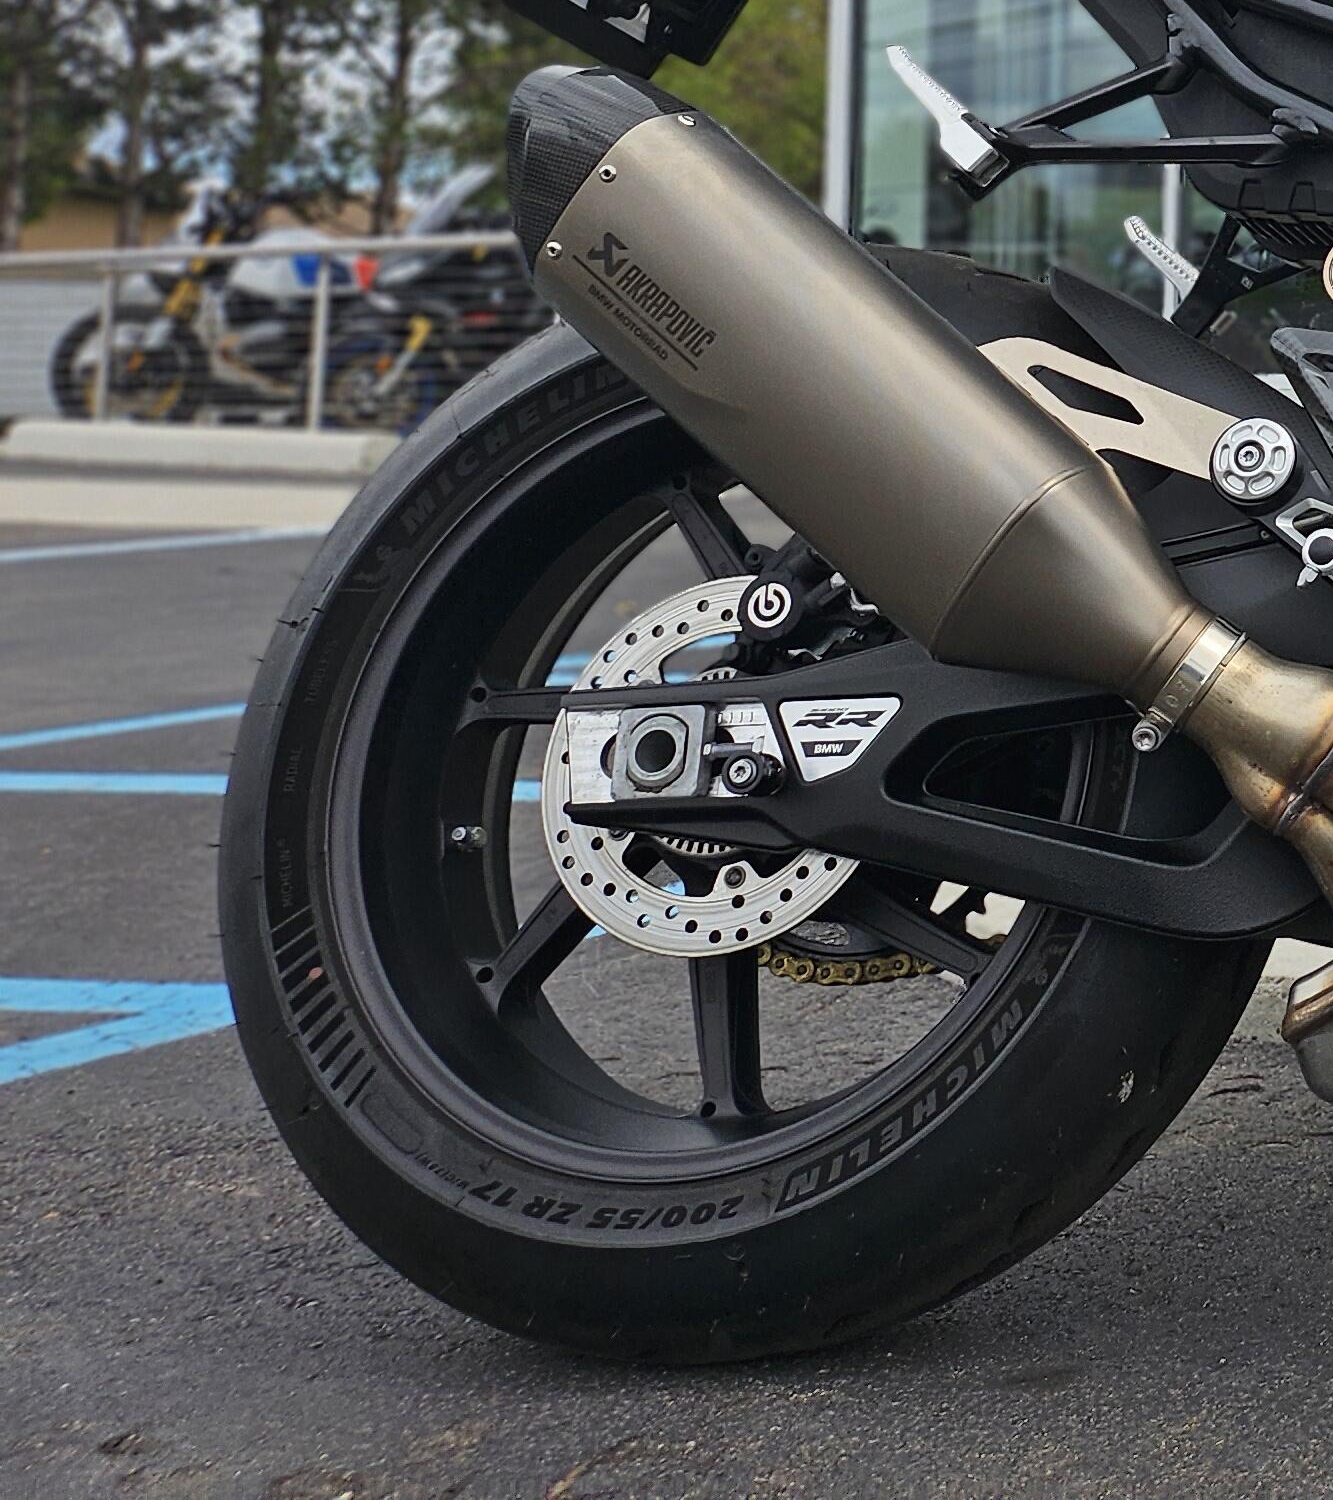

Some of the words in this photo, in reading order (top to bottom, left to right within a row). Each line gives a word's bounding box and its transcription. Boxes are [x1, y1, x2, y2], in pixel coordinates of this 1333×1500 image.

[588, 283, 614, 310] BMW
[400, 366, 627, 537] MICHELIN
[792, 709, 888, 729] RR
[813, 742, 845, 755] BMW
[784, 1000, 1023, 1203] MICHELIN
[467, 1180, 519, 1210] 17
[523, 1196, 583, 1226] ZR
[587, 1194, 745, 1231] 200/55
